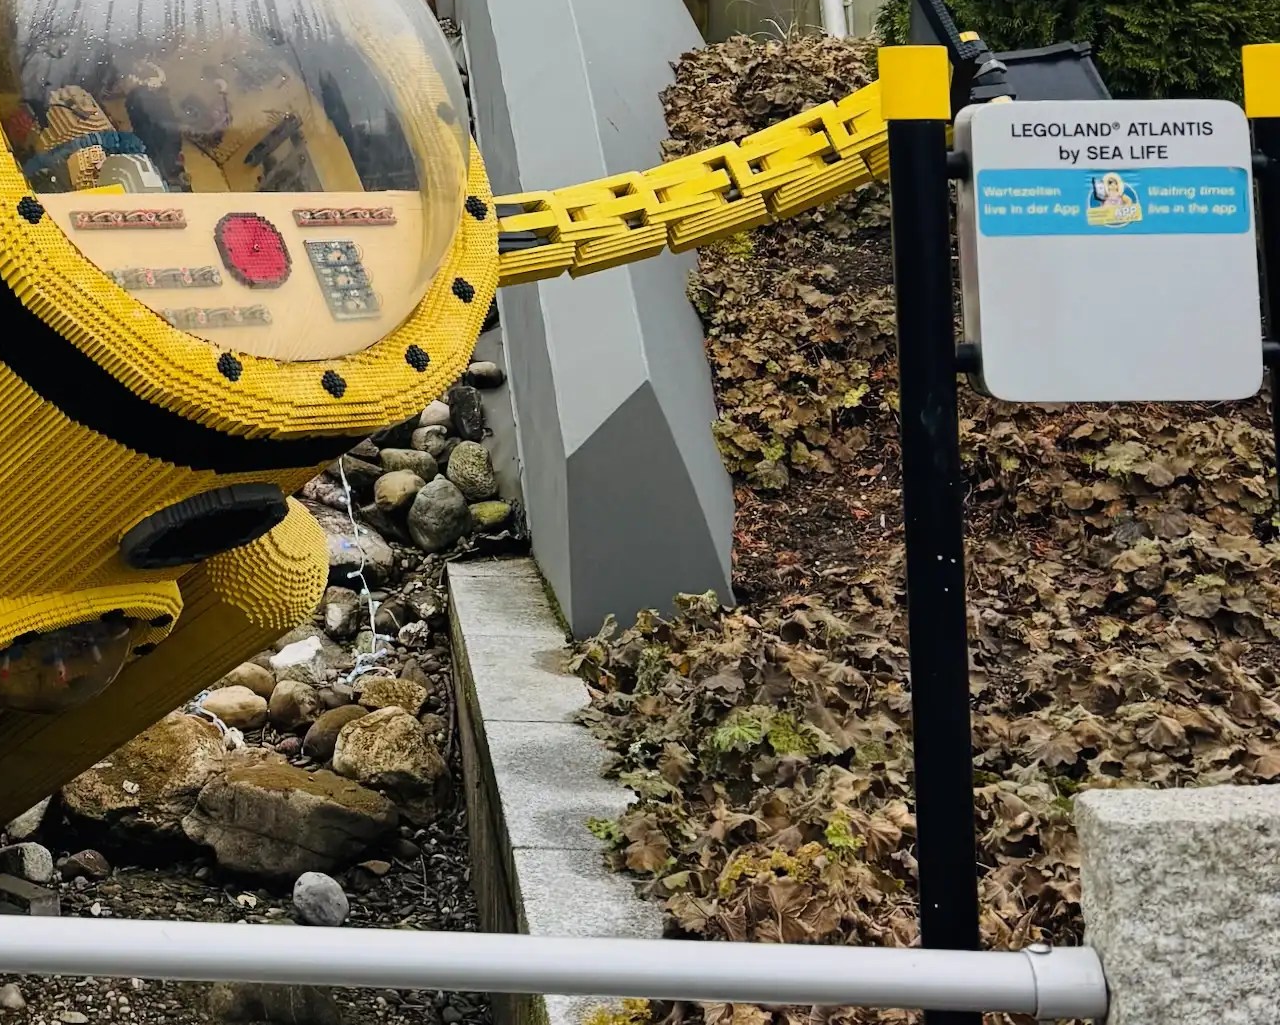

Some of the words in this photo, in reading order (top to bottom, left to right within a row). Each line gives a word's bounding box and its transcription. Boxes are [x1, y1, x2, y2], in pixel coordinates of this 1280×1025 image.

[1127, 121, 1214, 137] ATLANTIS
[1058, 145, 1080, 164] by
[1087, 146, 1124, 160] SEA
[1130, 145, 1169, 160] LIFE
[1053, 202, 1080, 217] App
[1188, 202, 1209, 215] the
[1211, 203, 1237, 217] app
